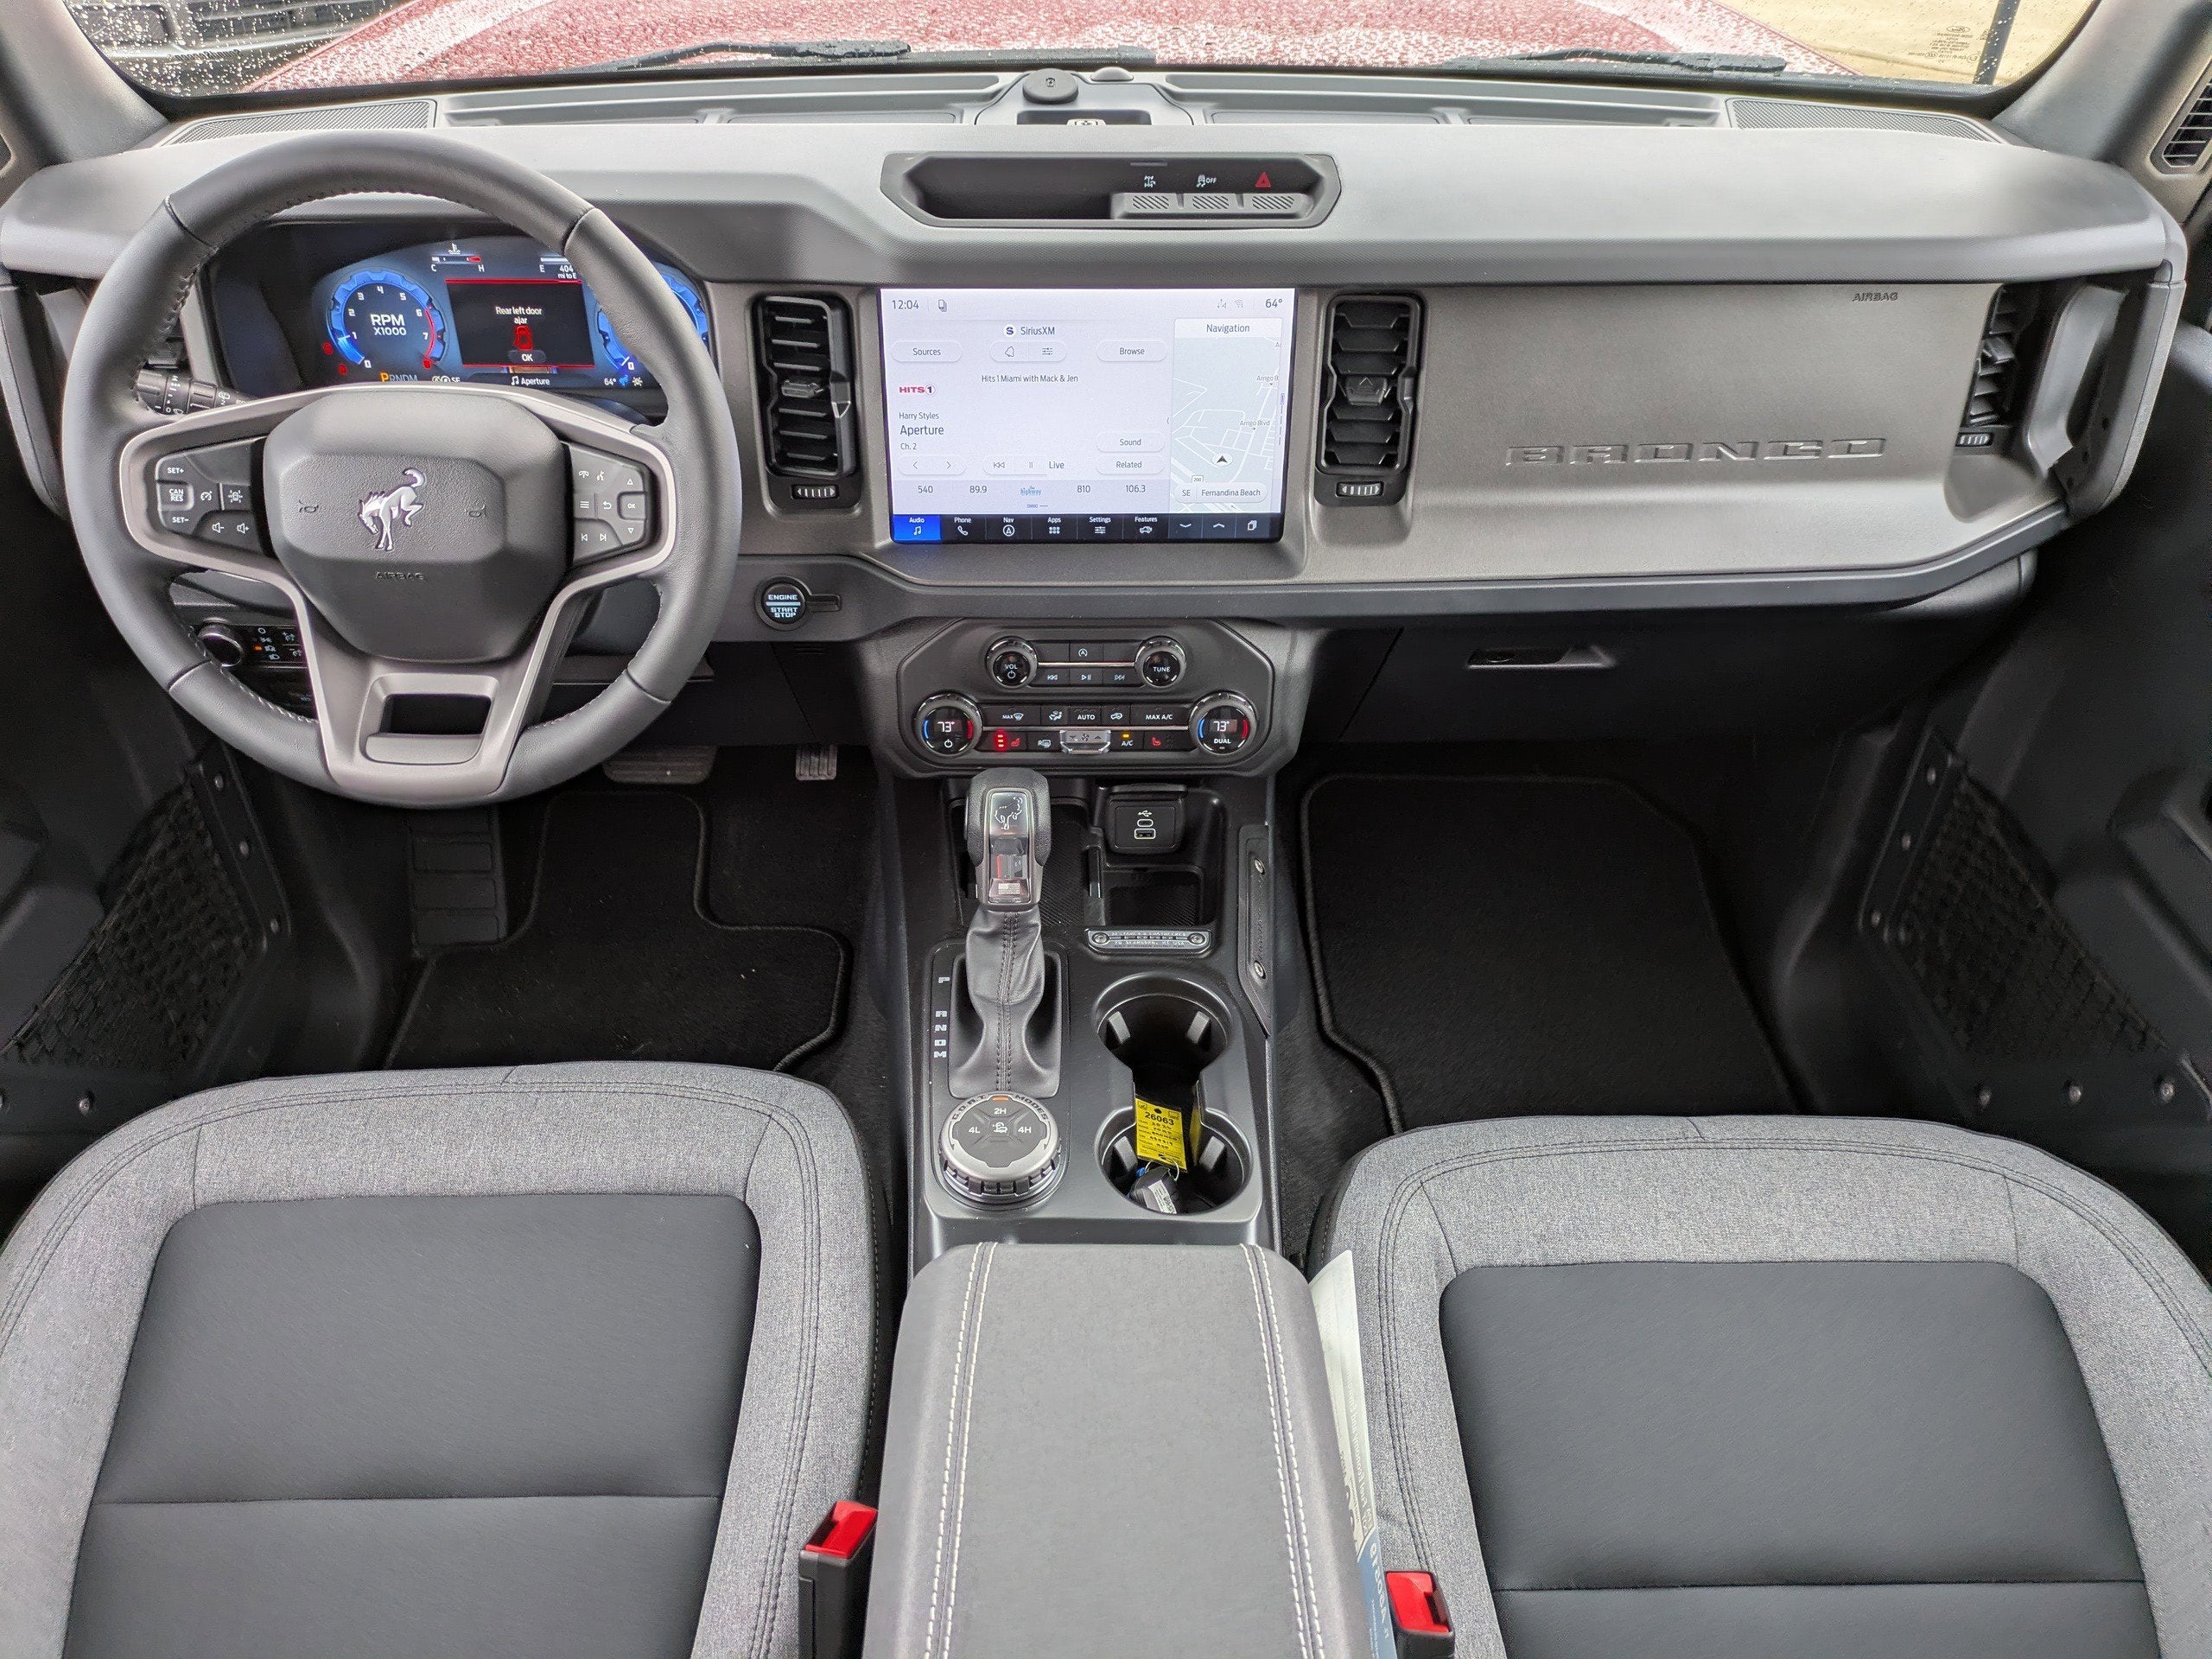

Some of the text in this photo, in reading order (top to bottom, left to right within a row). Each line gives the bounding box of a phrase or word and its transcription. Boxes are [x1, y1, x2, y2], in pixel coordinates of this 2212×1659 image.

[377, 285, 385, 294] 4
[357, 292, 365, 301] 3
[399, 292, 407, 301] 5
[1852, 292, 1899, 302] AIRBAG
[892, 300, 919, 310] 12:04
[1265, 298, 1283, 308] 64°
[416, 308, 423, 317] 6
[513, 306, 525, 315] left
[526, 306, 542, 315] door
[370, 314, 405, 326] RPM
[374, 327, 407, 336] X1000
[1020, 327, 1055, 335] SiriusXM
[1206, 324, 1250, 334] Navigation
[423, 332, 429, 340] 7
[521, 353, 533, 362] OK
[364, 359, 372, 368] 0
[627, 362, 635, 371] 0
[521, 378, 550, 386] Aperture
[604, 378, 616, 386] 64°
[899, 412, 939, 421] Harry Styles
[900, 425, 944, 436] Aperture
[1506, 438, 1887, 465] BRONCO
[1077, 485, 1091, 493] 810
[1126, 485, 1146, 493] 106.3
[938, 721, 956, 733] 73°
[1213, 721, 1230, 732] 73°
[1015, 1094, 1049, 1121] MODES
[1145, 1111, 1174, 1126] 26063
